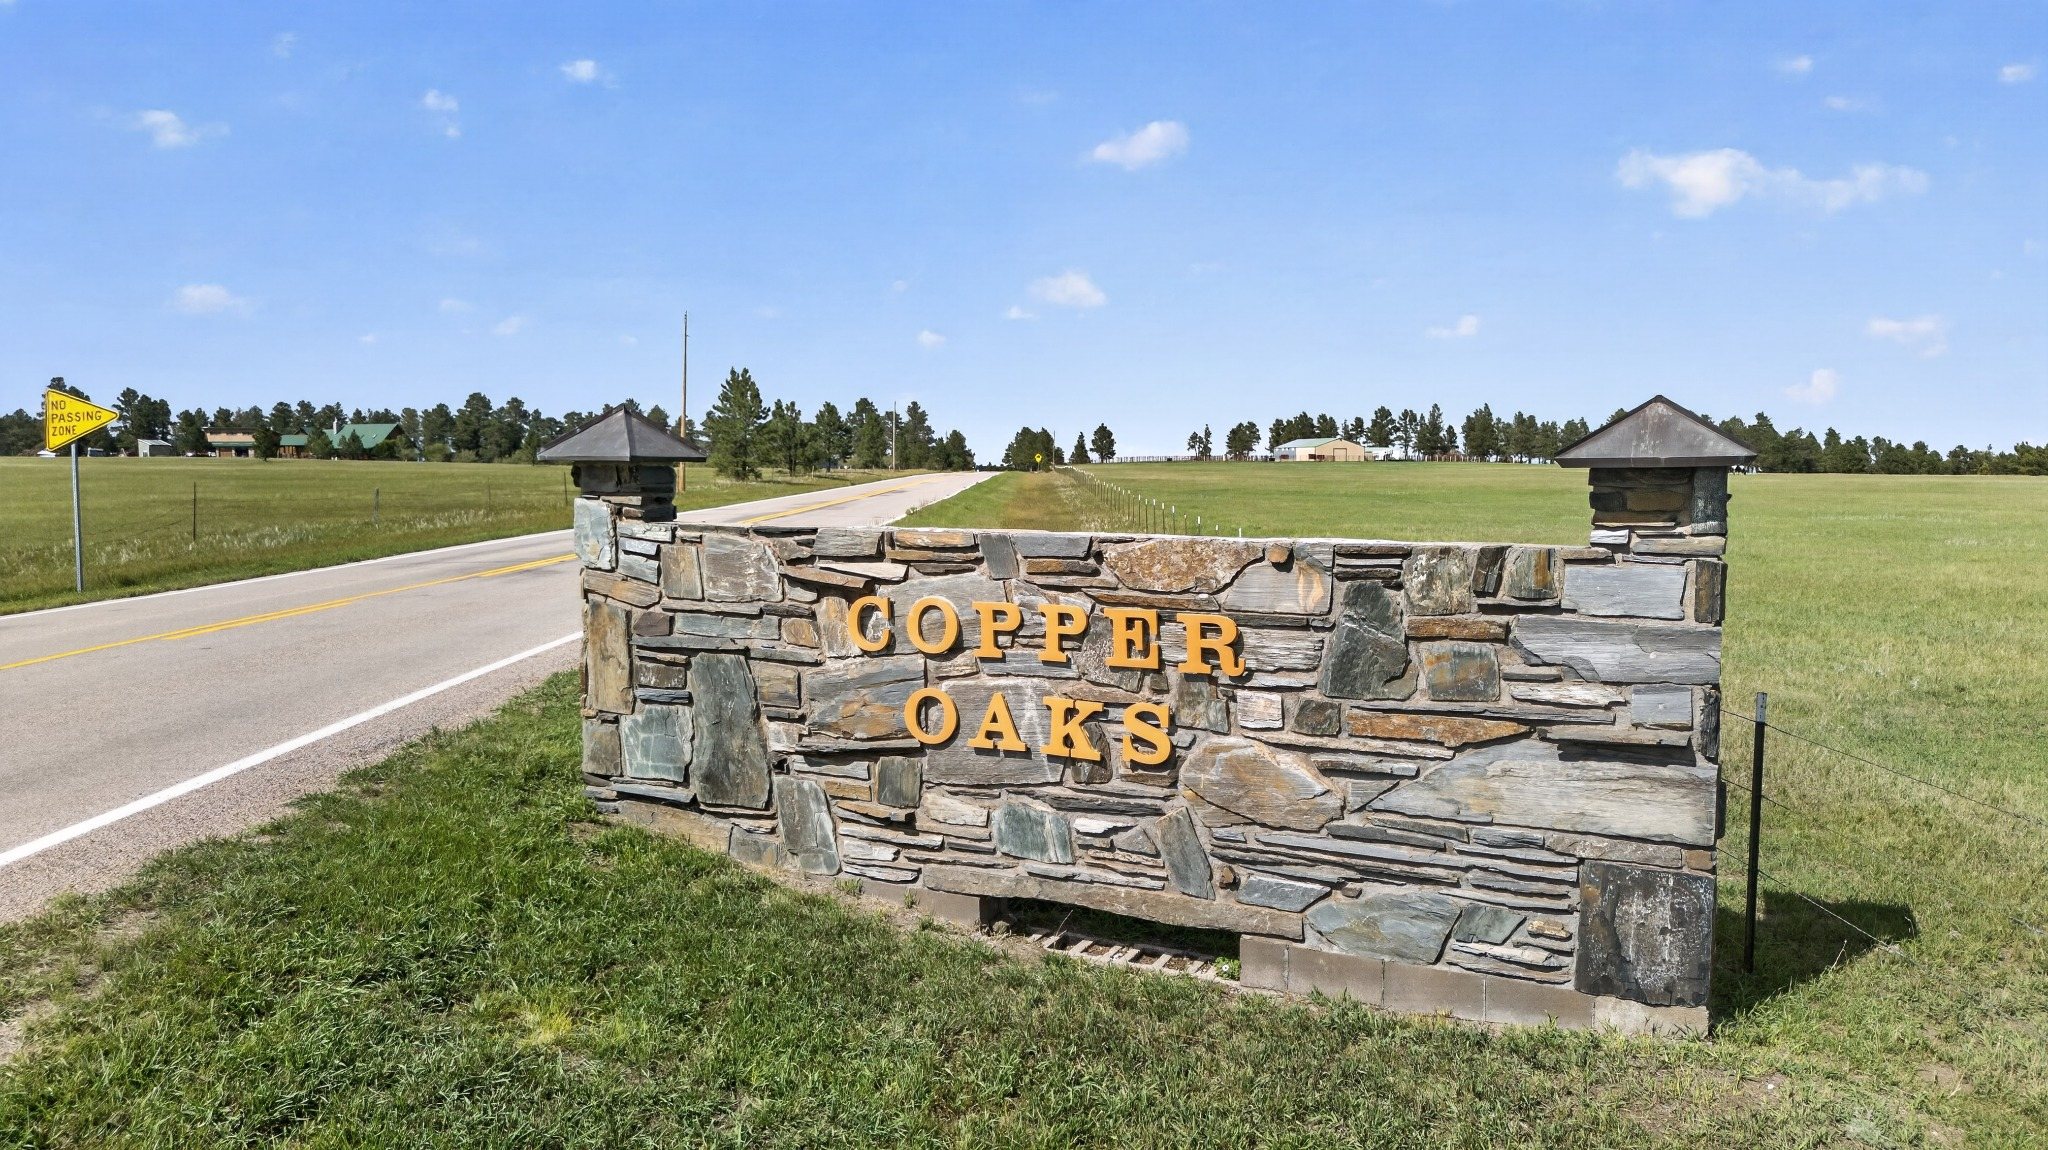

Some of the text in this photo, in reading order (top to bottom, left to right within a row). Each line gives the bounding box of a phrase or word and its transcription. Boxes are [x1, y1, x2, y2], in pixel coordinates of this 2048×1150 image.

[51, 400, 66, 410] NO
[51, 411, 102, 423] PASSING
[52, 425, 77, 437] ZONE
[847, 595, 1247, 678] COPPER
[904, 687, 1172, 765] OAKS
